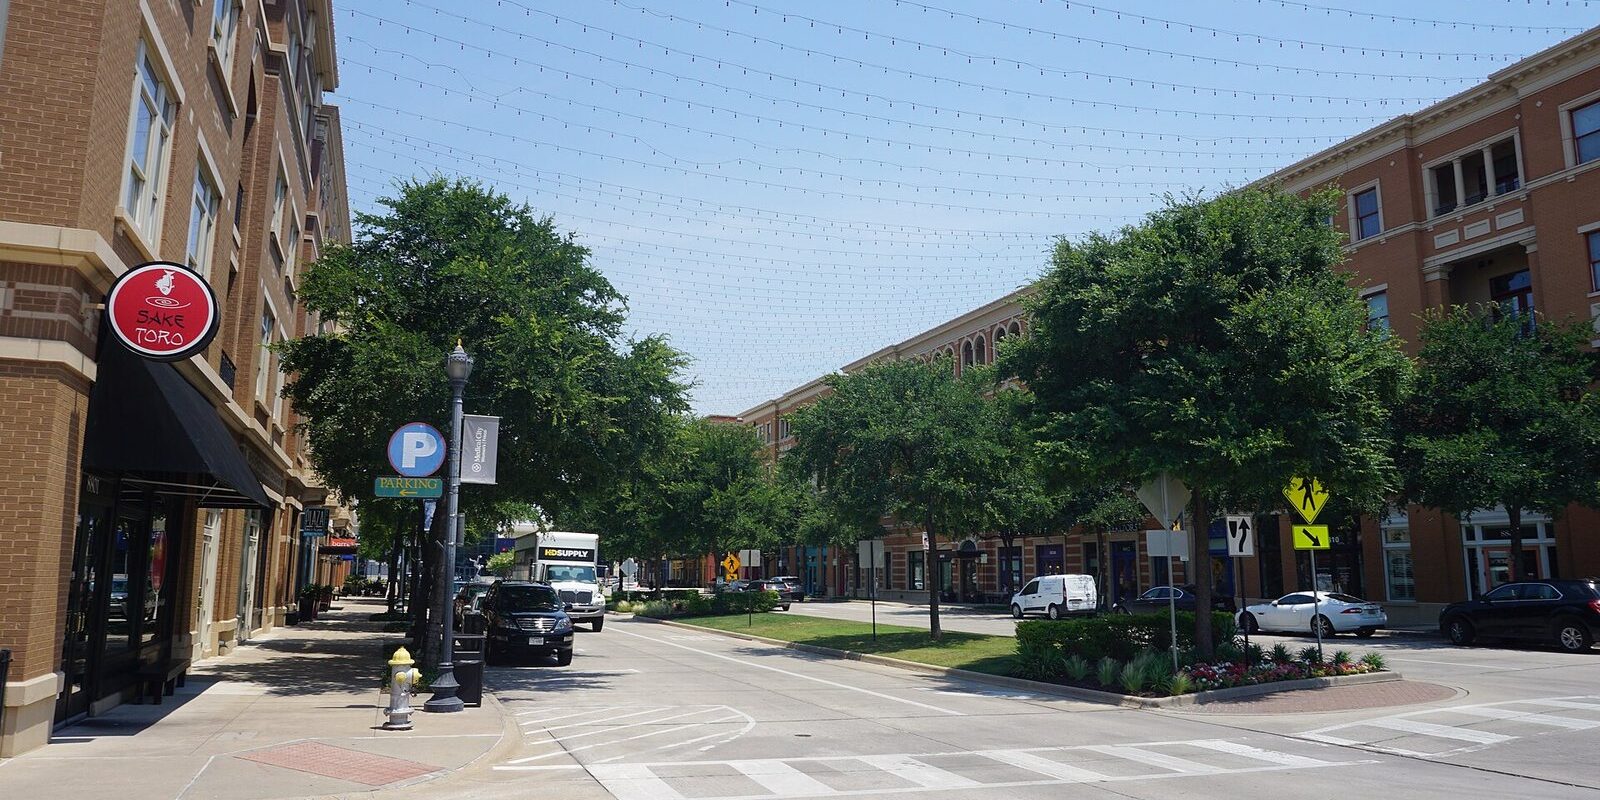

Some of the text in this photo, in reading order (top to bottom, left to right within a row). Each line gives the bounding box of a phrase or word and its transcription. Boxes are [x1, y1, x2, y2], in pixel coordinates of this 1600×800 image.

[136, 310, 185, 329] SAKE
[135, 328, 184, 346] TORO
[402, 432, 437, 468] P
[474, 426, 484, 463] Medical City
[380, 477, 437, 489] PARKING
